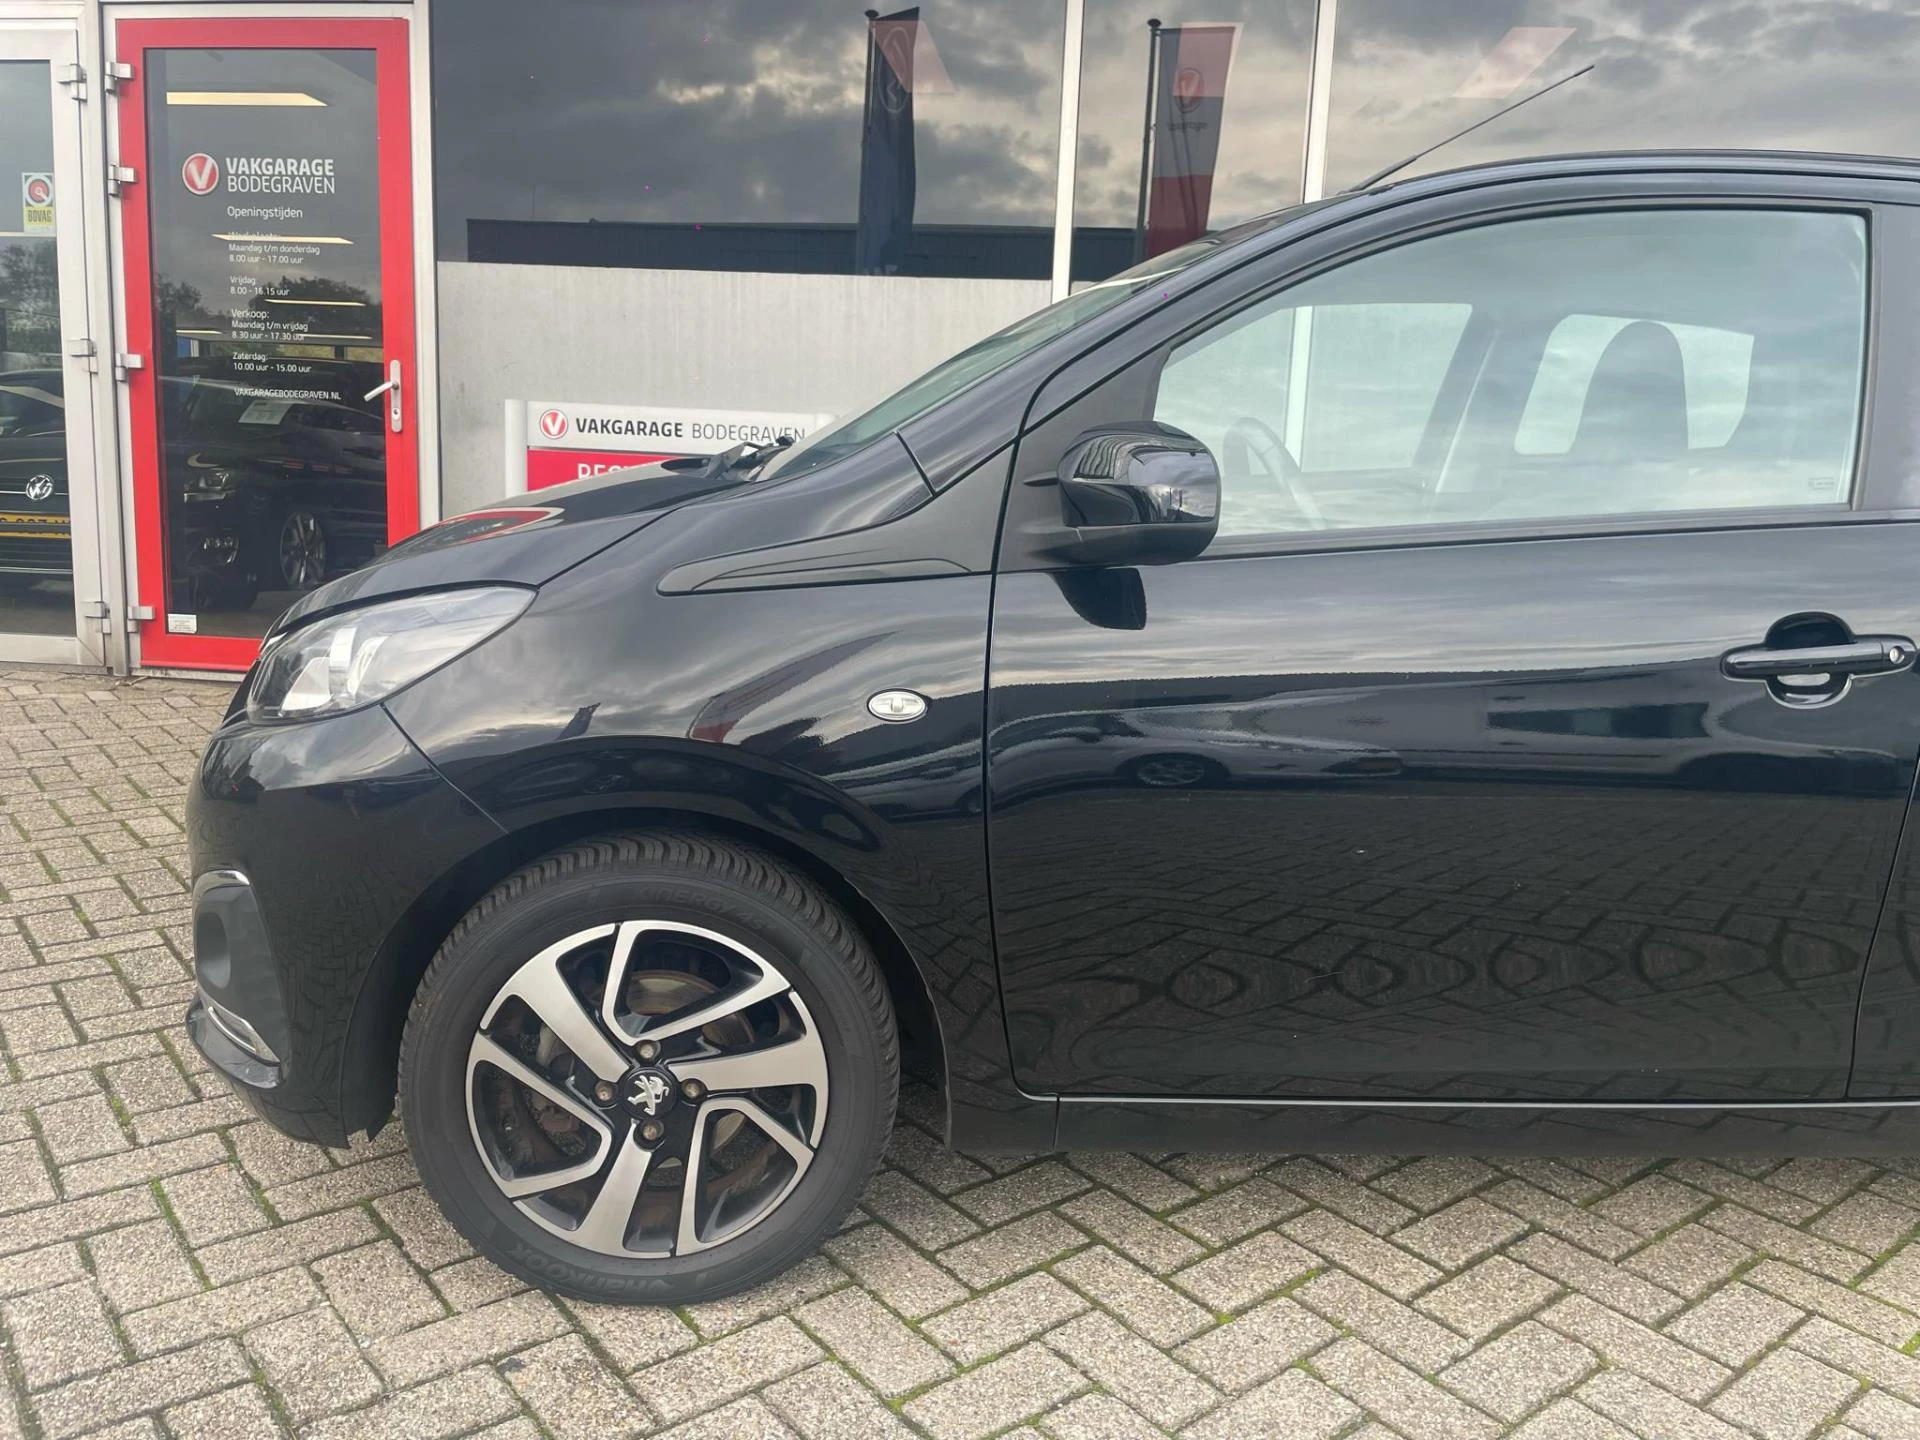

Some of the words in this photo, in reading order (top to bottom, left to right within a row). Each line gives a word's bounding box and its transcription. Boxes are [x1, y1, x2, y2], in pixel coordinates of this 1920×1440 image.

[225, 157, 334, 176] VAKGARAGE
[227, 176, 335, 194] BODEGRAVEN
[227, 206, 303, 220] Openingstijden
[229, 243, 262, 253] Maandag
[264, 244, 278, 252] t/m
[280, 245, 320, 255] donderdag
[229, 254, 246, 263] 8.00
[268, 255, 289, 264] 17.00
[230, 275, 256, 286] Vrijdag
[230, 286, 247, 295] 8.00
[255, 287, 275, 296] 16.15
[231, 308, 270, 320] Verkoop:
[231, 320, 265, 331] Maandag
[266, 321, 281, 330] t/m
[282, 322, 308, 332] vrijdag
[231, 331, 249, 339] 8.30
[270, 332, 292, 340] 17.30
[234, 363, 254, 371] 10.00
[276, 364, 297, 373] 15.00
[234, 387, 342, 400] VAKGARAGEBODEGRAVEN.NL
[576, 417, 683, 438] VAKGARAGE
[692, 423, 805, 442] BODEGRAVEN
